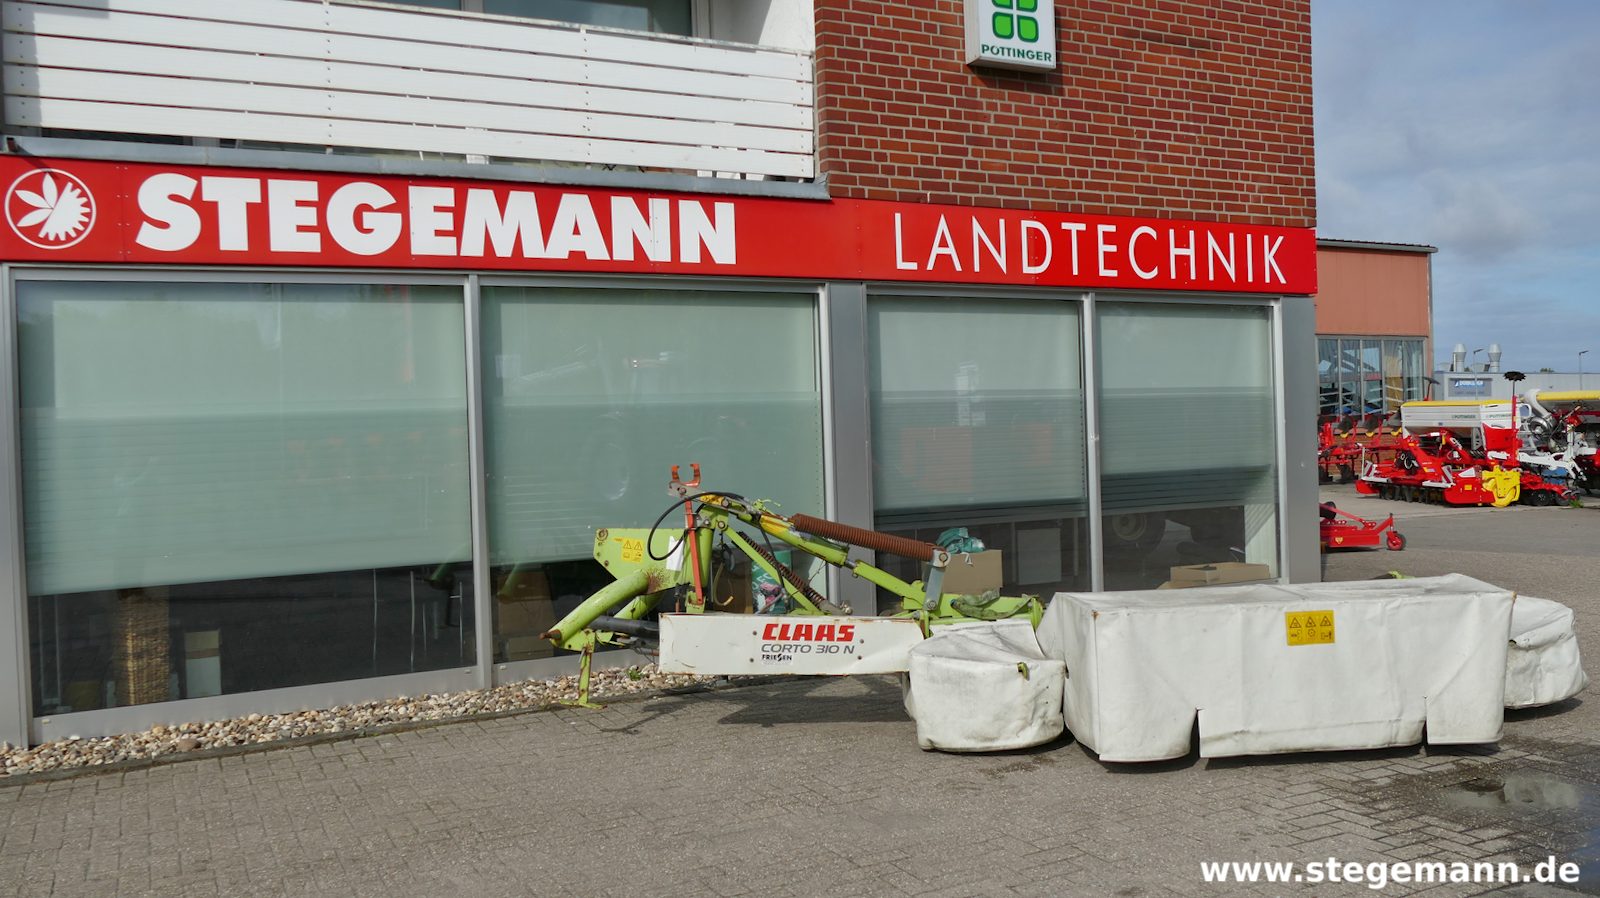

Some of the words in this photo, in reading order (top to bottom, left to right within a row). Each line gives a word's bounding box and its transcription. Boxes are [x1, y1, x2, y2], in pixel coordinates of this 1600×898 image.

[136, 172, 737, 265] STEGEMANN
[894, 212, 1287, 284] LANDTECHNIK
[762, 623, 855, 642] CLAAS
[761, 643, 811, 653] CORTO
[816, 645, 840, 654] 310
[843, 645, 855, 654] N
